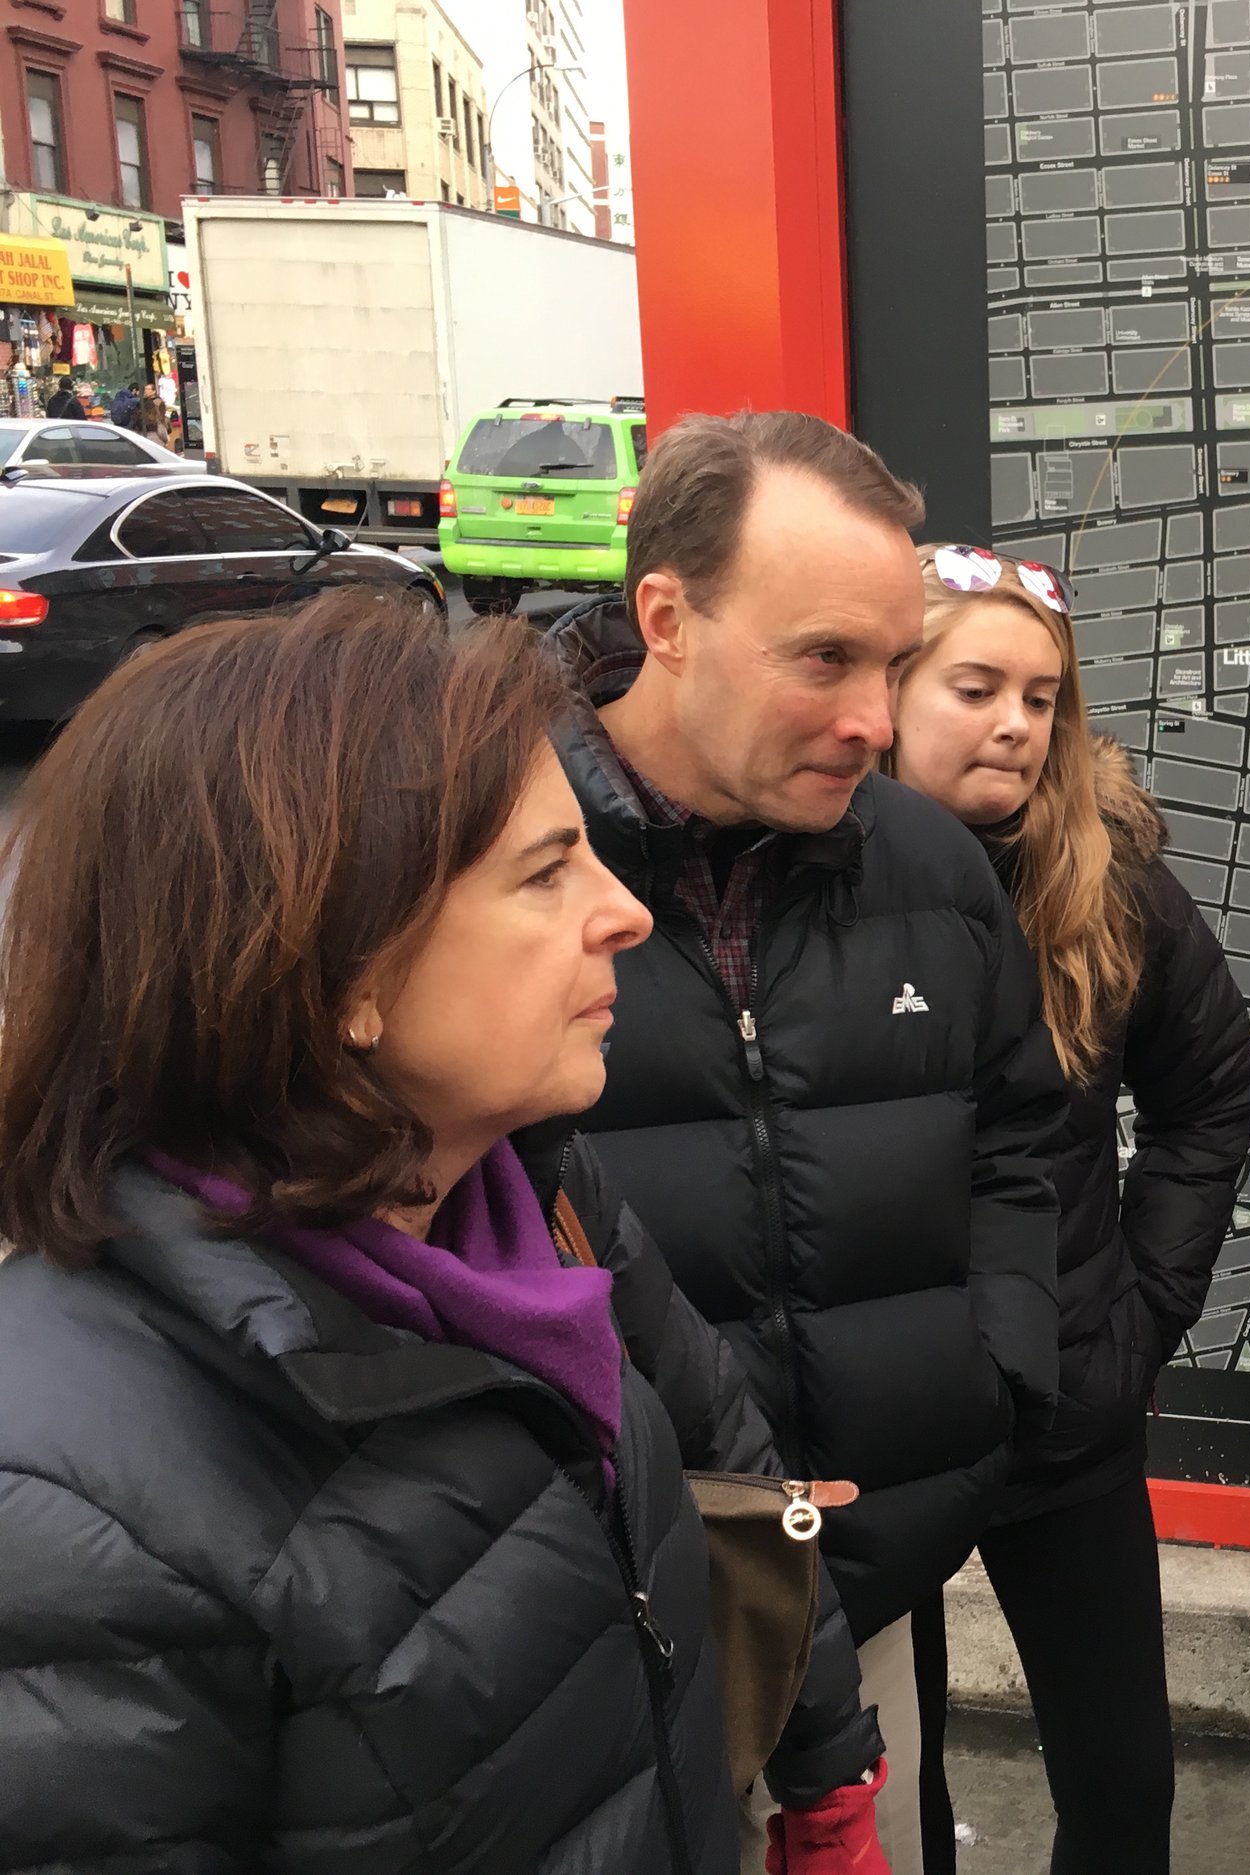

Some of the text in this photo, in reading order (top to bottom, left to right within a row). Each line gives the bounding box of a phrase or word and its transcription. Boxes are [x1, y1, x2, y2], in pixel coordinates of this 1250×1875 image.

[20, 252, 51, 270] JALAL
[7, 271, 65, 290] SHOP INC.
[16, 289, 41, 299] CANAL
